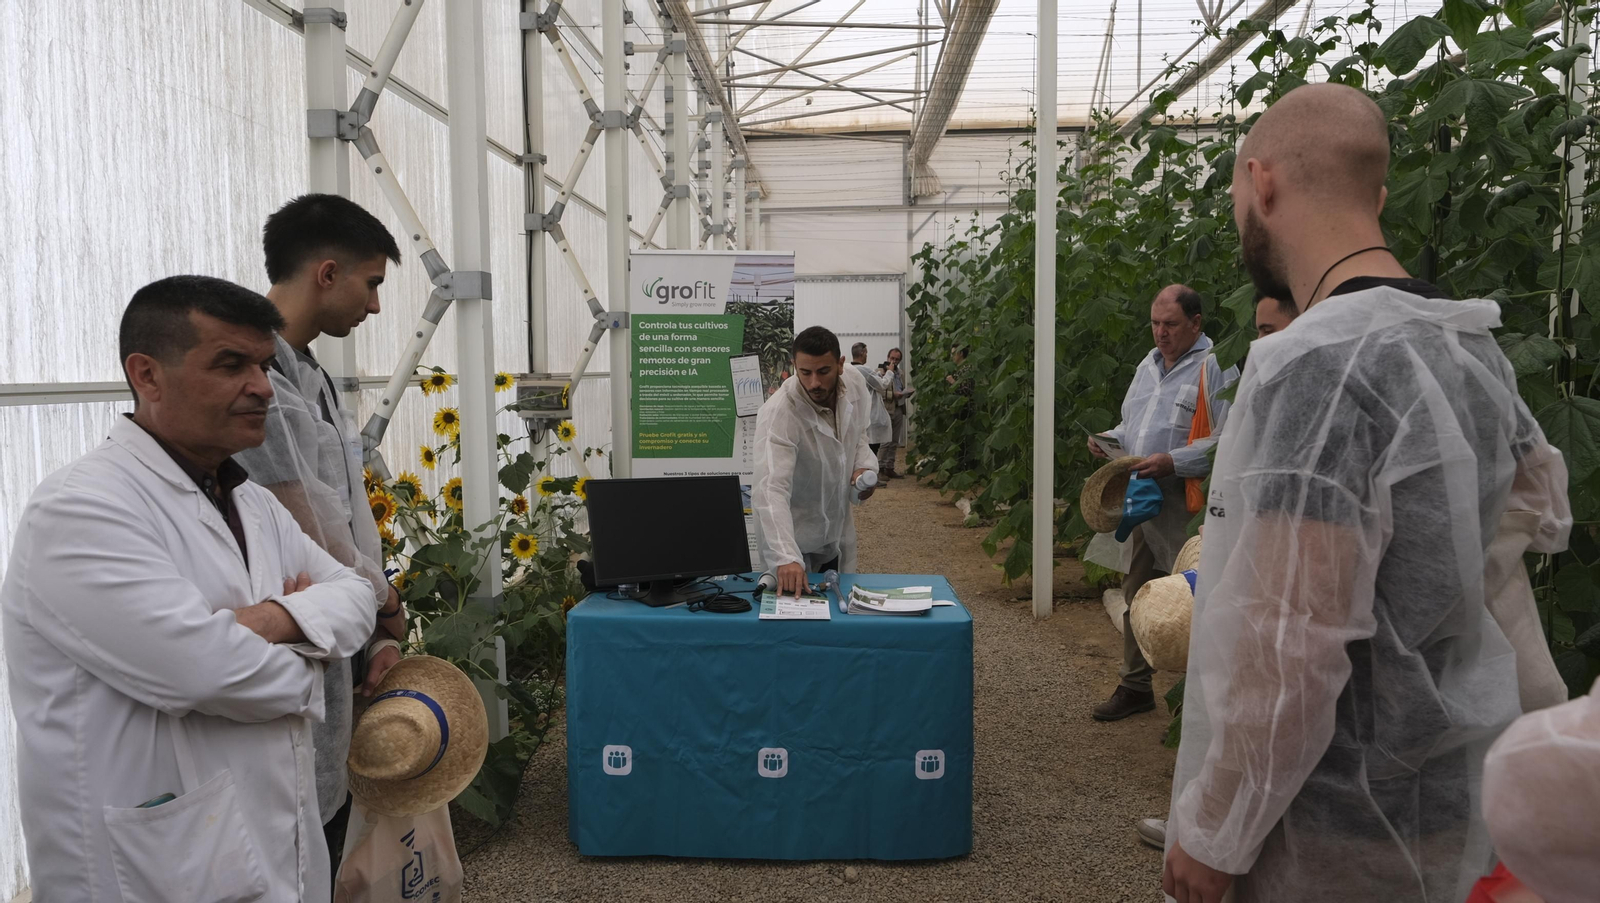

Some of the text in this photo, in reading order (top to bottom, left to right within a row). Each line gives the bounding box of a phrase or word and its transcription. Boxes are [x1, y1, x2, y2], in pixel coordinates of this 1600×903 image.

[656, 280, 716, 304] grofit
[639, 321, 677, 329] Controla
[694, 321, 728, 329] cultivos
[639, 333, 650, 341] de
[671, 333, 698, 341] forma
[639, 345, 673, 353] sencilla
[677, 356, 689, 364] de
[691, 358, 711, 366] gran
[639, 368, 680, 377] precisión
[688, 368, 698, 376] IA
